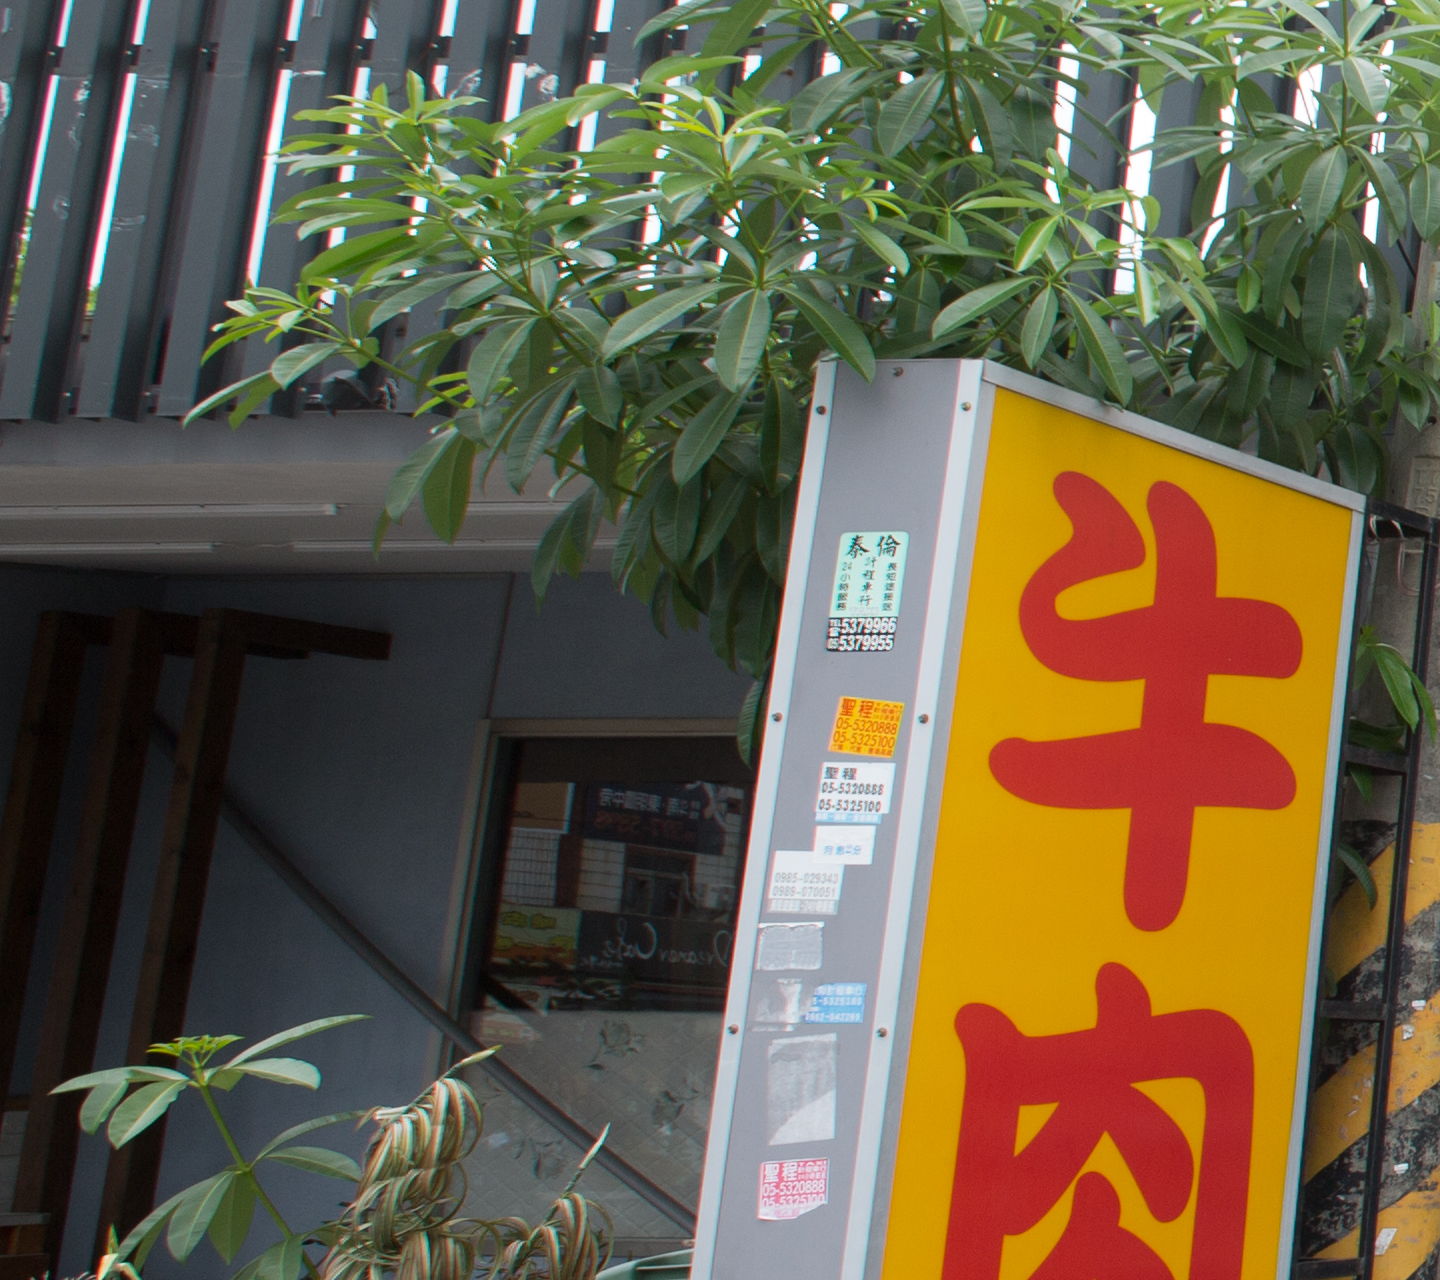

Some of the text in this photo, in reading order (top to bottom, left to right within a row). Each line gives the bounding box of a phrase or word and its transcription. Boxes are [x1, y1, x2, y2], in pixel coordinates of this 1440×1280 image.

[841, 617, 897, 634] 5379966
[839, 635, 894, 651] 5379955
[840, 698, 875, 718] 聖程
[836, 717, 898, 735] 05-5320888
[833, 730, 895, 748] 05-5325100
[821, 781, 884, 795] 05-5320888
[818, 798, 882, 812] 05-5325100
[764, 1162, 798, 1182] 聖程
[762, 1179, 825, 1197] 05-5320888
